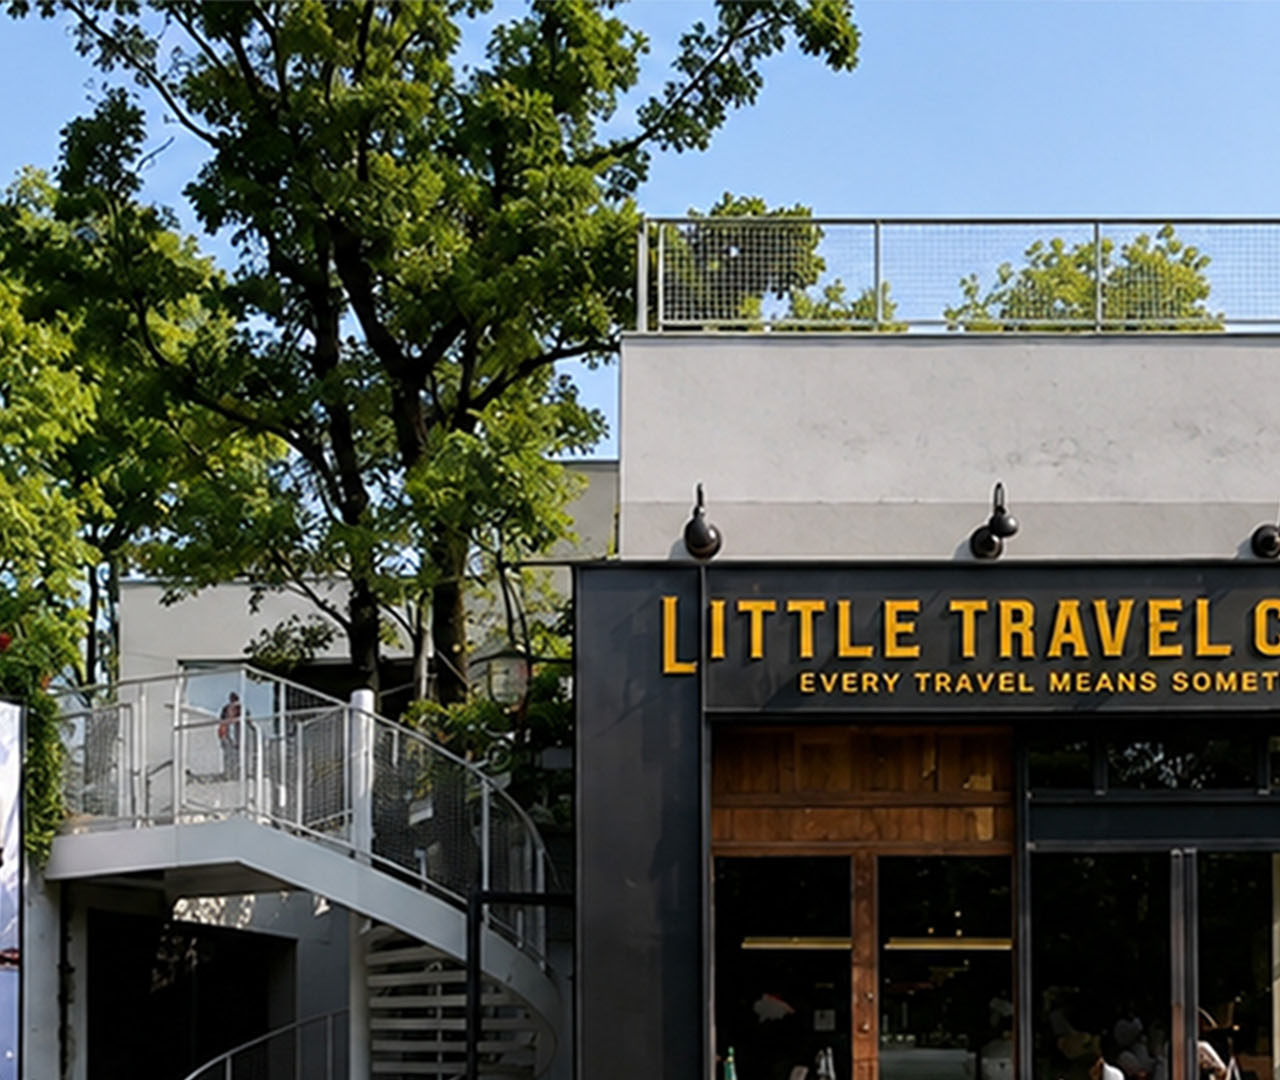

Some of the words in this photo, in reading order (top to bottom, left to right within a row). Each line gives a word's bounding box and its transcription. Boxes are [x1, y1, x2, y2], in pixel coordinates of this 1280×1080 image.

[662, 596, 920, 674] LITTLE
[949, 598, 1232, 657] TRAVEL
[800, 672, 900, 692] EVERY
[915, 672, 1034, 692] TRAVEL
[1049, 672, 1158, 692] MEANS
